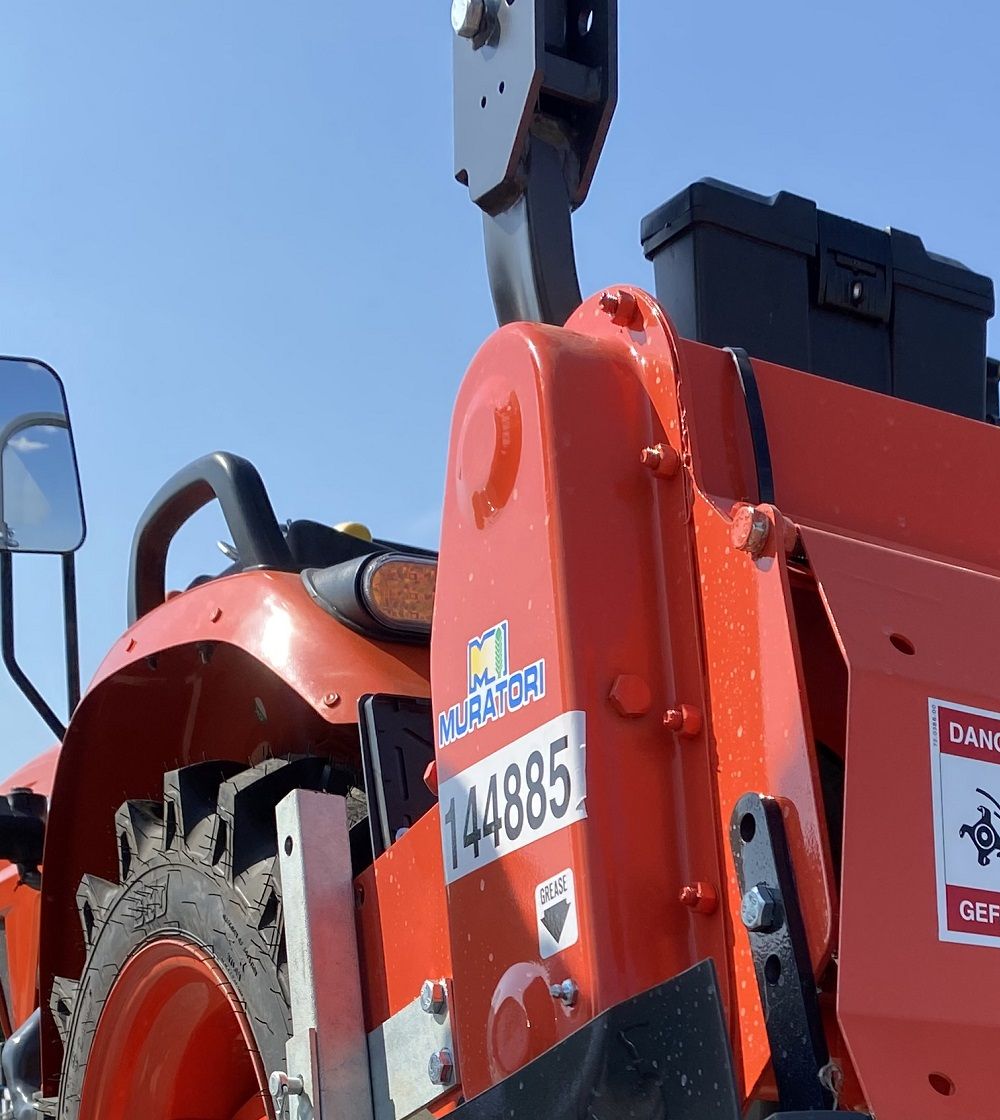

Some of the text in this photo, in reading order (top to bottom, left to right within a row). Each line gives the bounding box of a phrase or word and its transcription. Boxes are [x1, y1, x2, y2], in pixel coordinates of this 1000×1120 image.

[439, 659, 545, 748] MURATORI
[444, 734, 572, 870] 144885
[540, 874, 568, 905] GREASE
